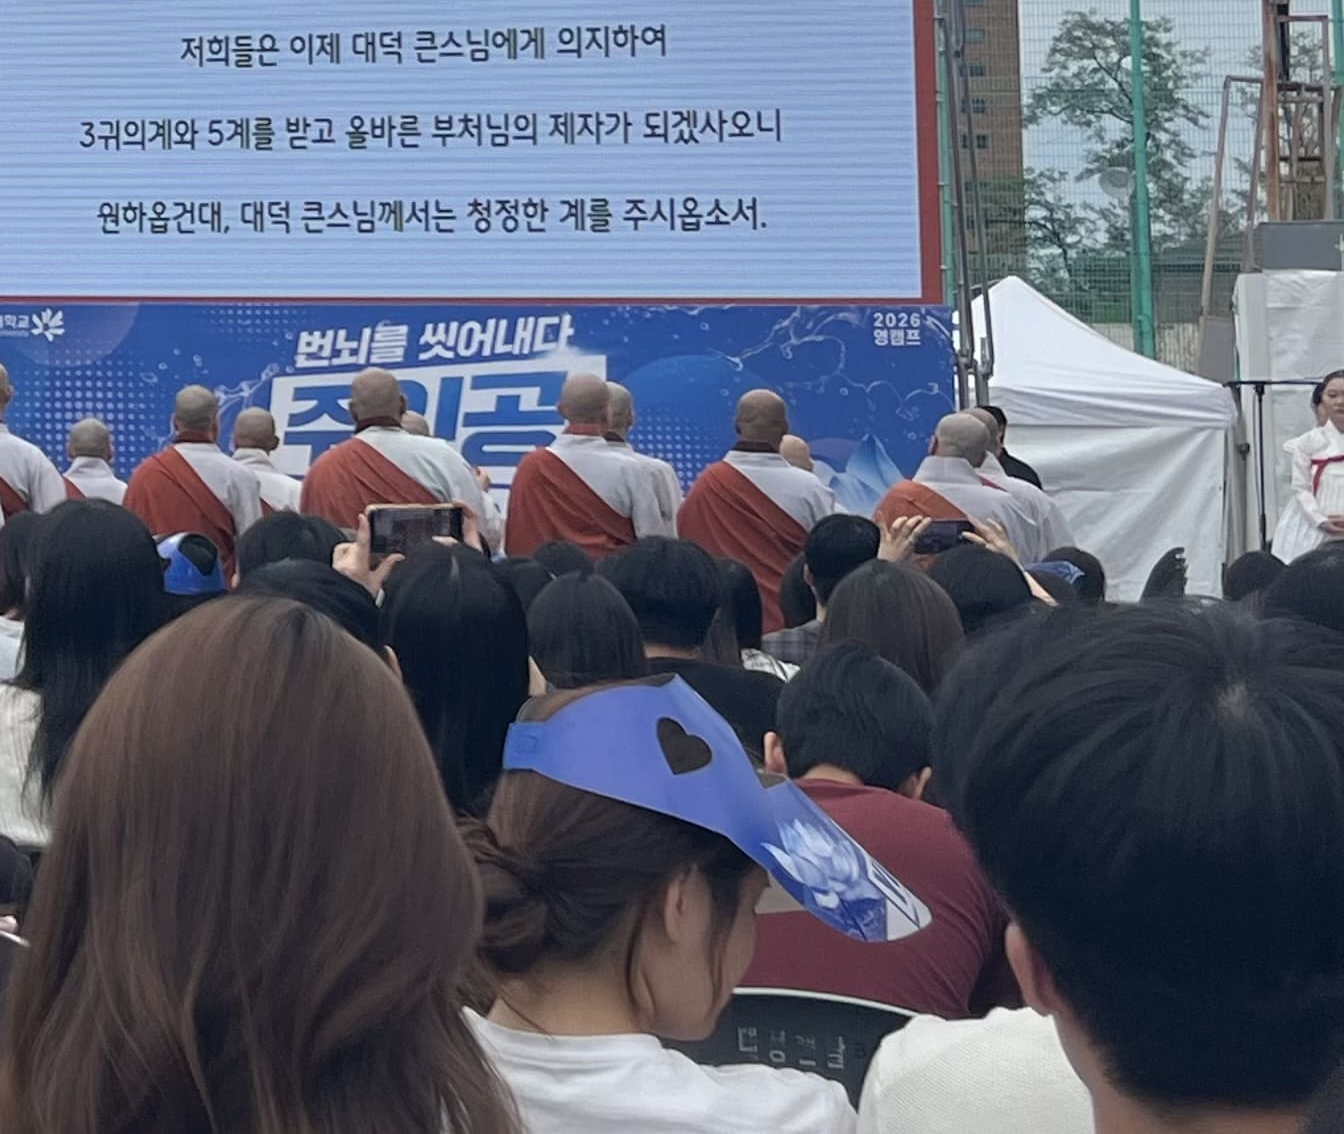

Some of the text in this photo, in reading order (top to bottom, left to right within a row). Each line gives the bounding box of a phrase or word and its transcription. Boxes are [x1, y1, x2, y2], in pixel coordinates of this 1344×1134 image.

[180, 23, 667, 69] 저희들은 이제 대덕 큰스님에게 의지하여
[79, 108, 781, 152] 3귀의계와 5계를 받고 올바른 부처님의 제자가 되겠사오니
[96, 196, 767, 235] 원하옵건대, 대덕 큰스님께서는 청정한 계를 주시옵소서.
[295, 313, 576, 367] 번뇌를 씻어내다
[873, 312, 921, 327] 2026
[873, 329, 921, 346] 영캠프
